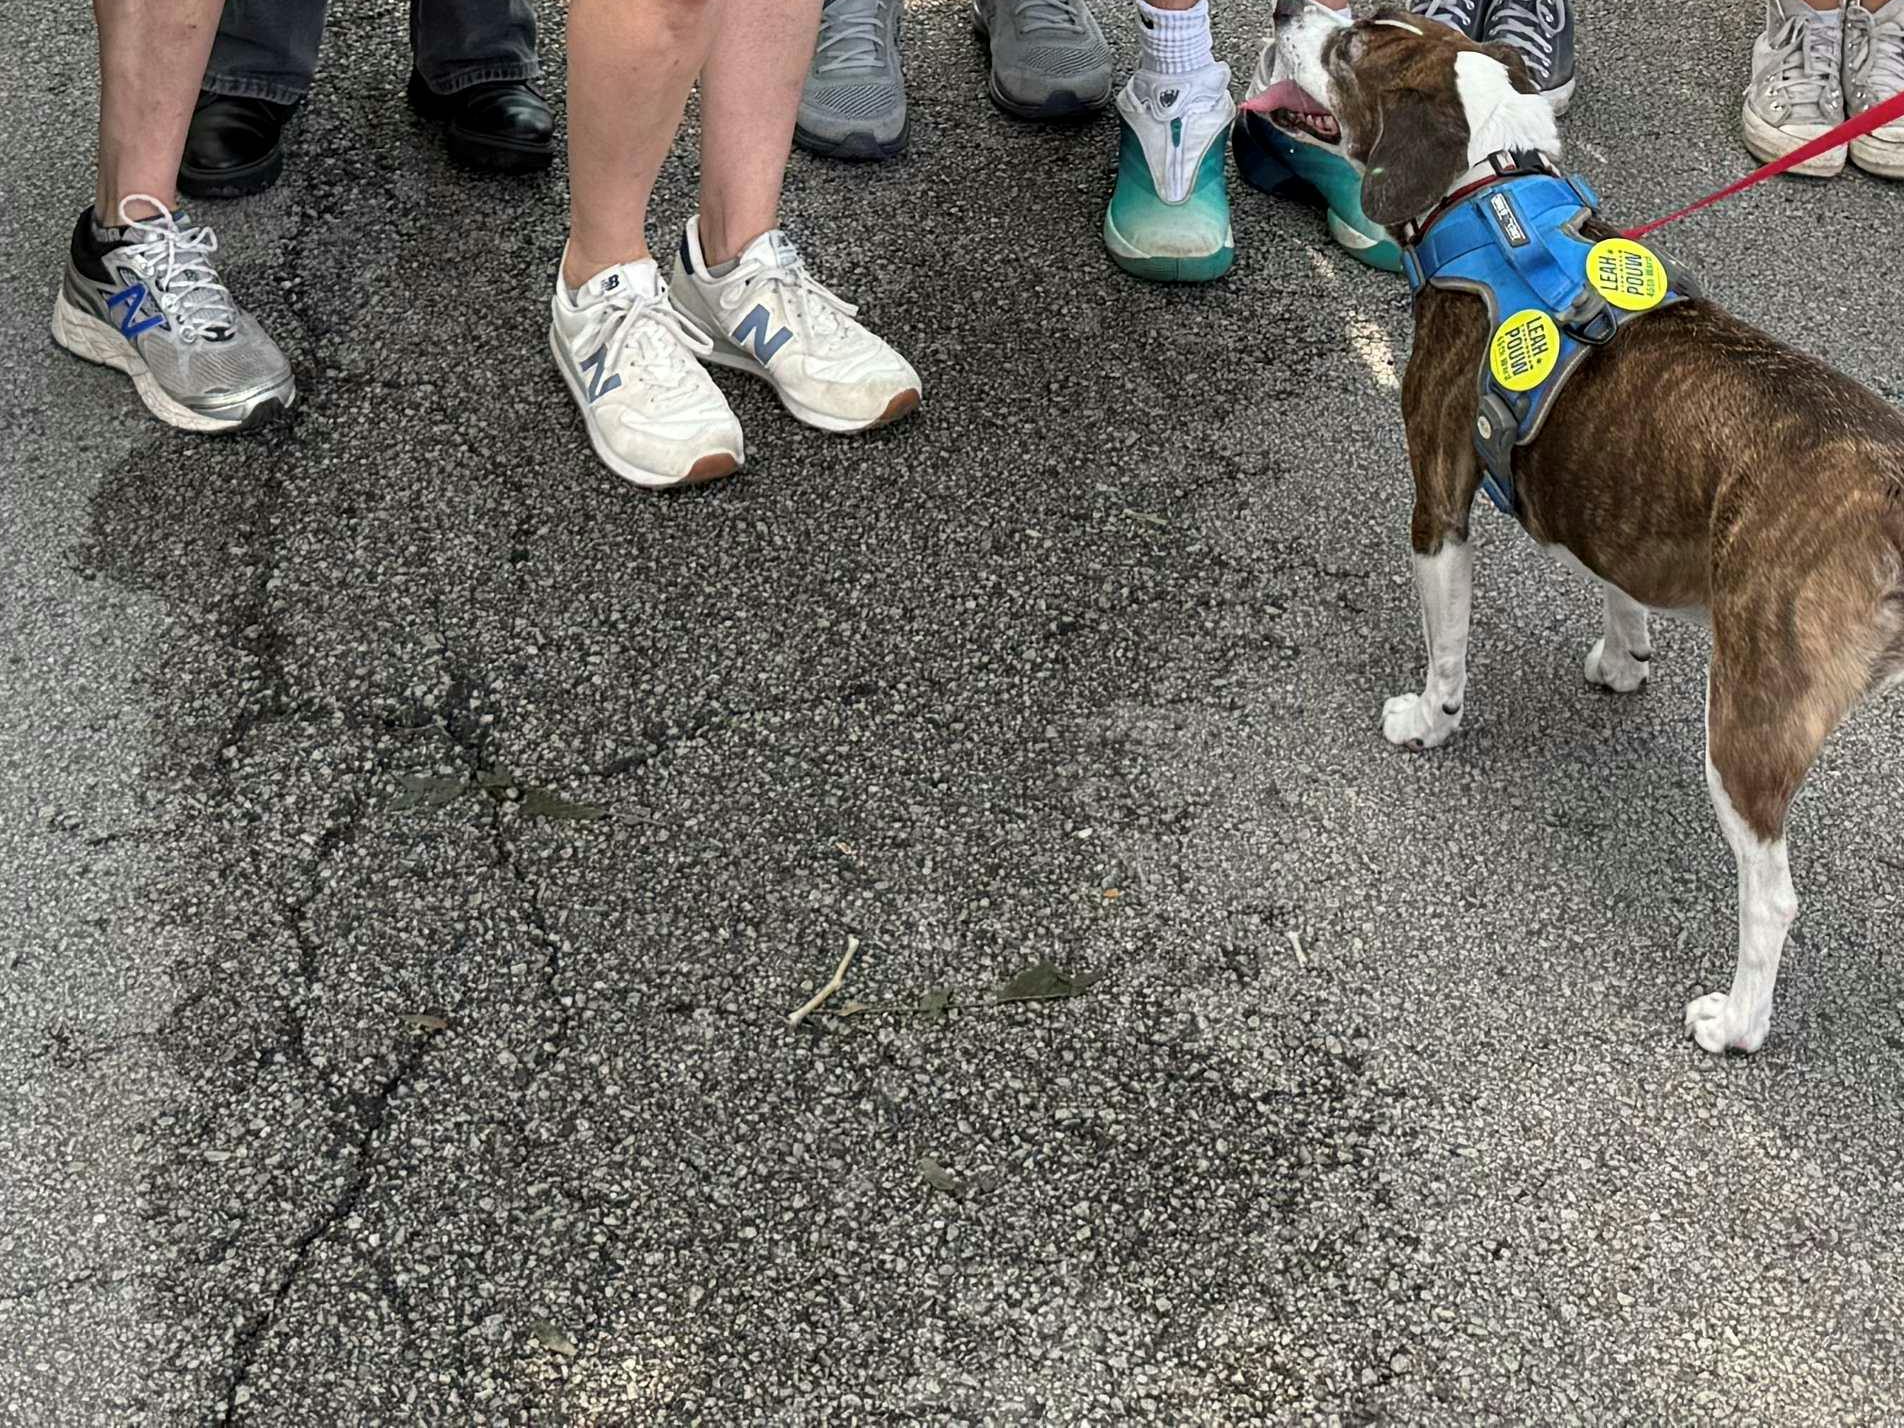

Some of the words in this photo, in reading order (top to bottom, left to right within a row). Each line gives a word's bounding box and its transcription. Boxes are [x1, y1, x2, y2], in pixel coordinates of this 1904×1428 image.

[1598, 255, 1618, 291] LEAH
[1623, 251, 1645, 296] POUW
[1504, 327, 1529, 376] POUW
[1526, 316, 1549, 356] LEAH
